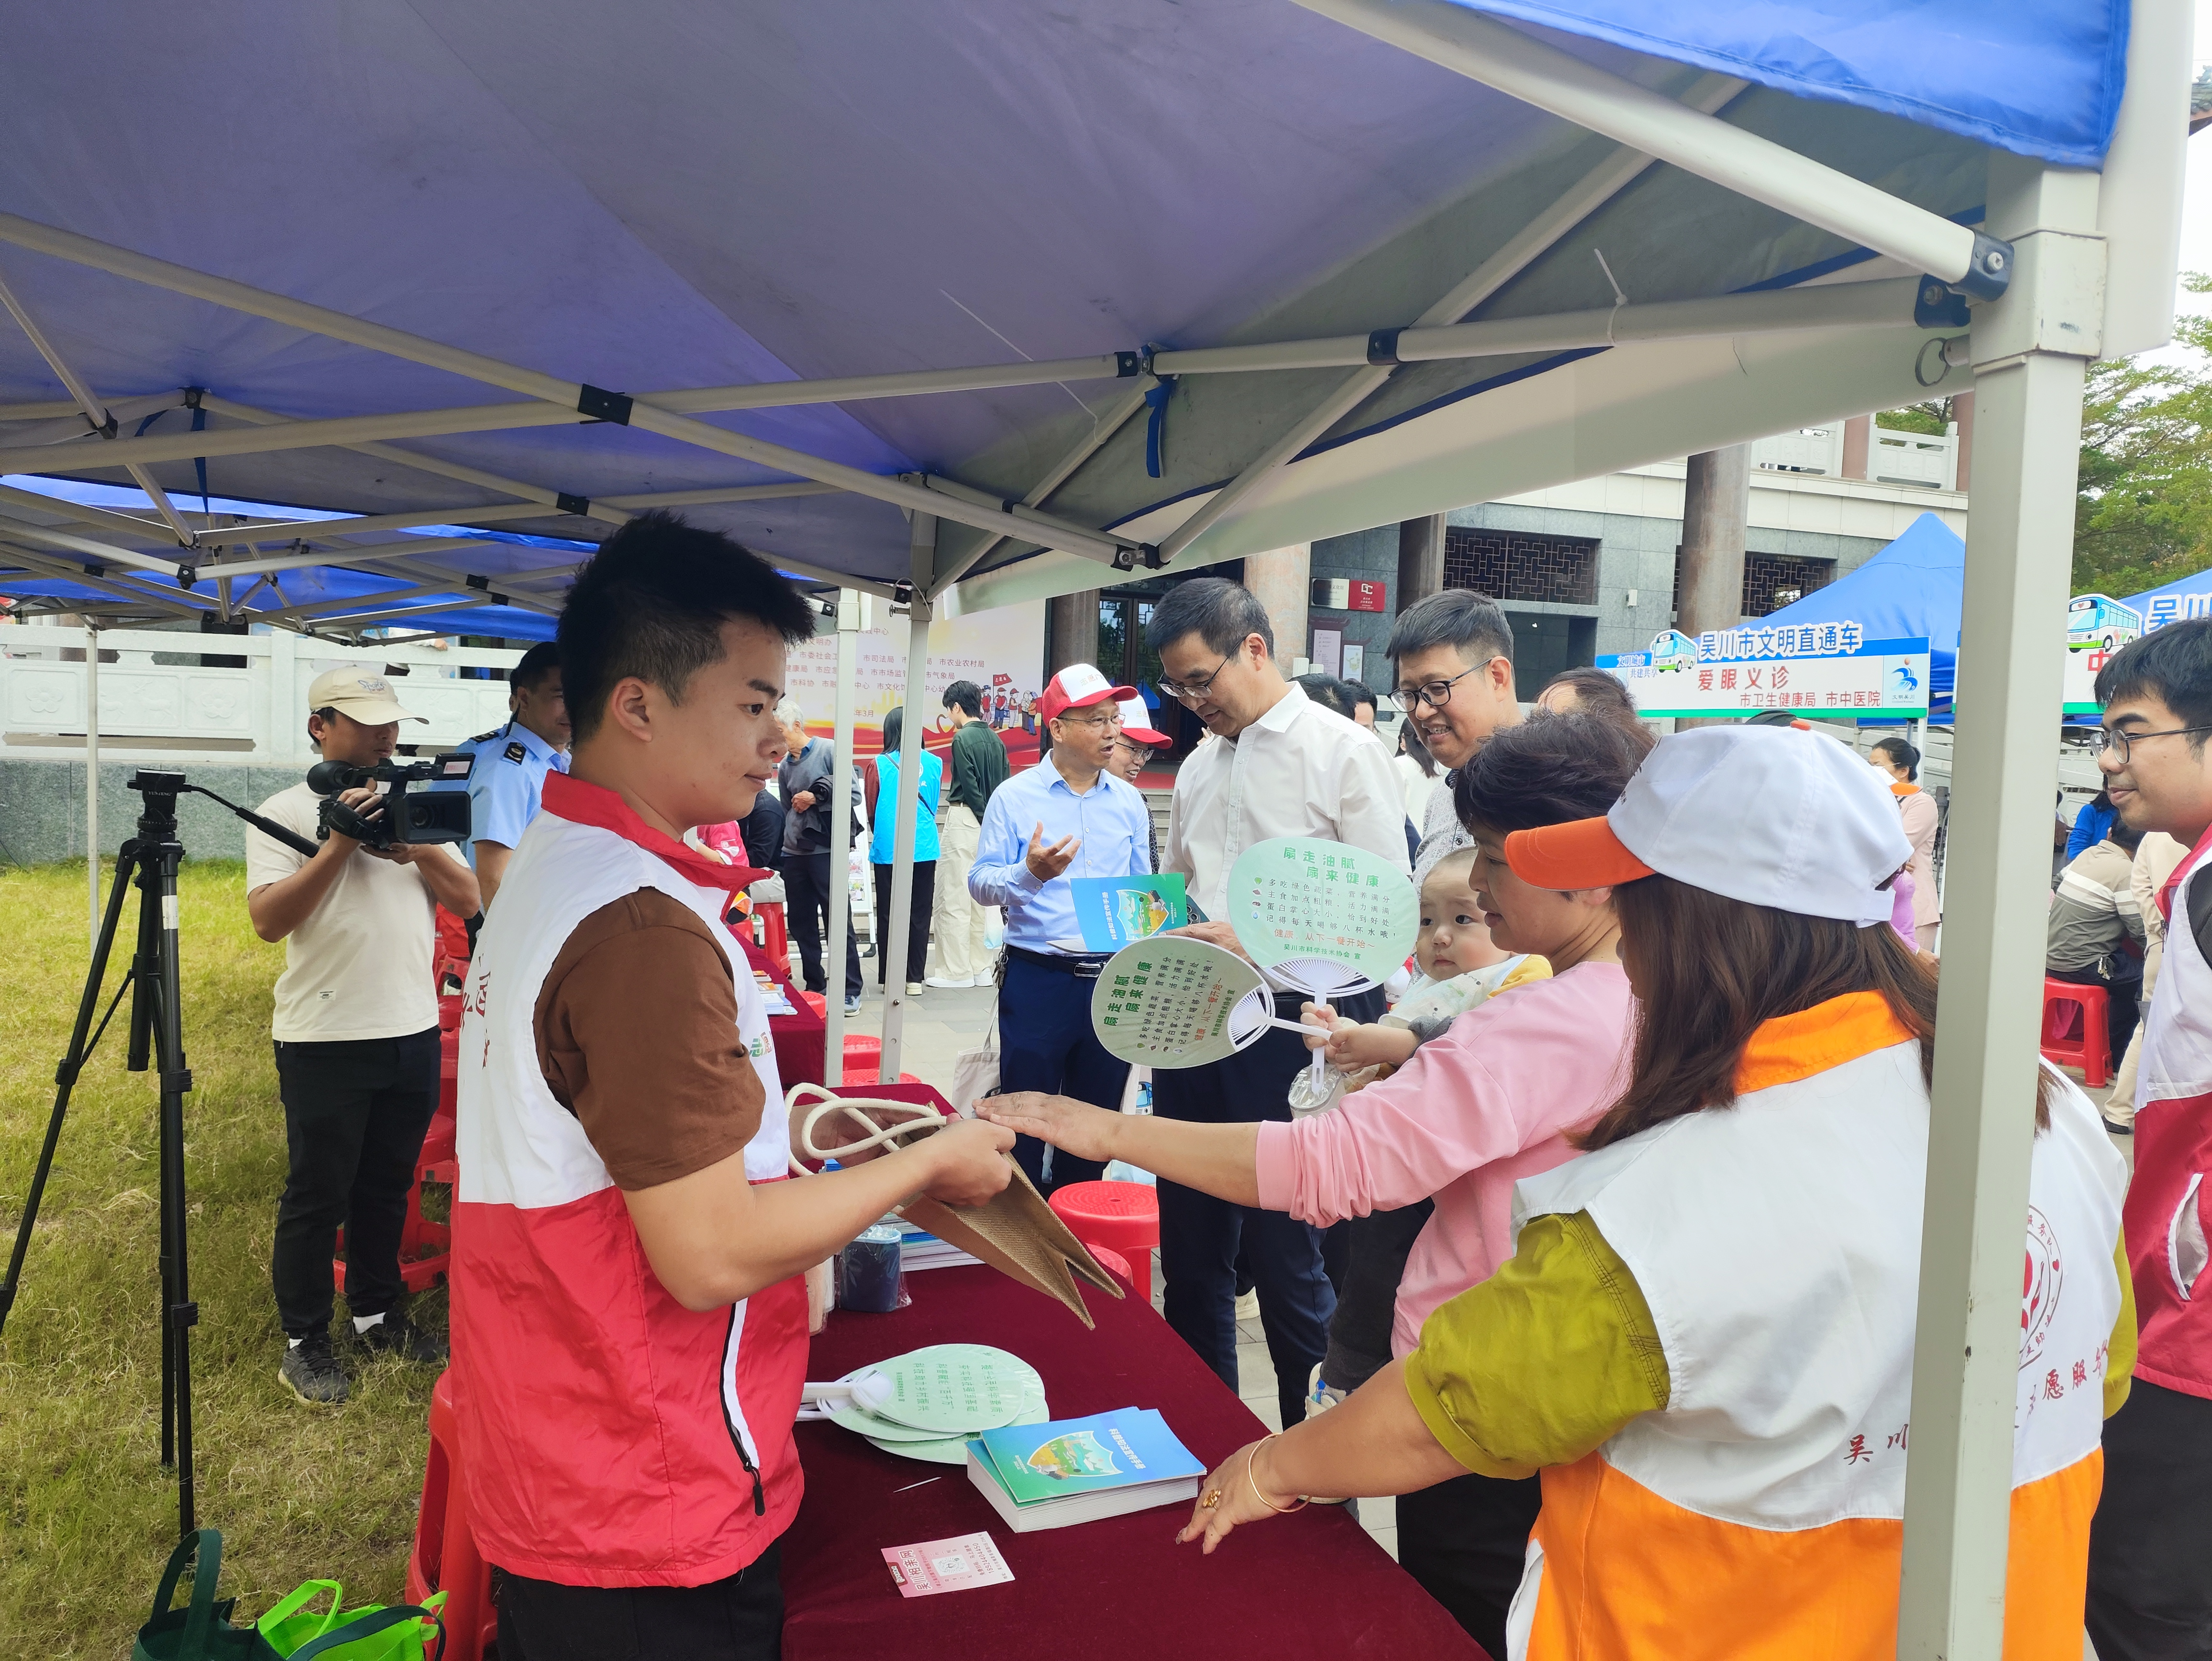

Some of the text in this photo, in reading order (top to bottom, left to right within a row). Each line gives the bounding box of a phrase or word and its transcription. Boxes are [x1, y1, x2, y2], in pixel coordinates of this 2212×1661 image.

[1701, 623, 1860, 658] 吴川市文明直通车
[863, 654, 894, 664] 市司法局
[939, 658, 984, 668] 市农业农村局
[1617, 655, 1646, 667] 文明城市
[790, 679, 815, 687] 市科协
[1630, 668, 1658, 678] 共建共享
[1698, 665, 1790, 692] 爱眼义诊
[1740, 690, 1881, 708] 市卫生健康局 市中医院
[853, 709, 874, 718] 年3月
[1283, 846, 1356, 870] 扇走油腻
[1306, 866, 1380, 888] 扇来健康
[1283, 943, 1350, 959] 吴川市科学技术协会
[1125, 961, 1153, 1013] 扇来健康
[1103, 974, 1131, 1026] 扇走油腻
[749, 1030, 774, 1058] 志愿
[1107, 1428, 1147, 1470] 科普知法宣传手册
[899, 1550, 932, 1590] 吴川相亲网
